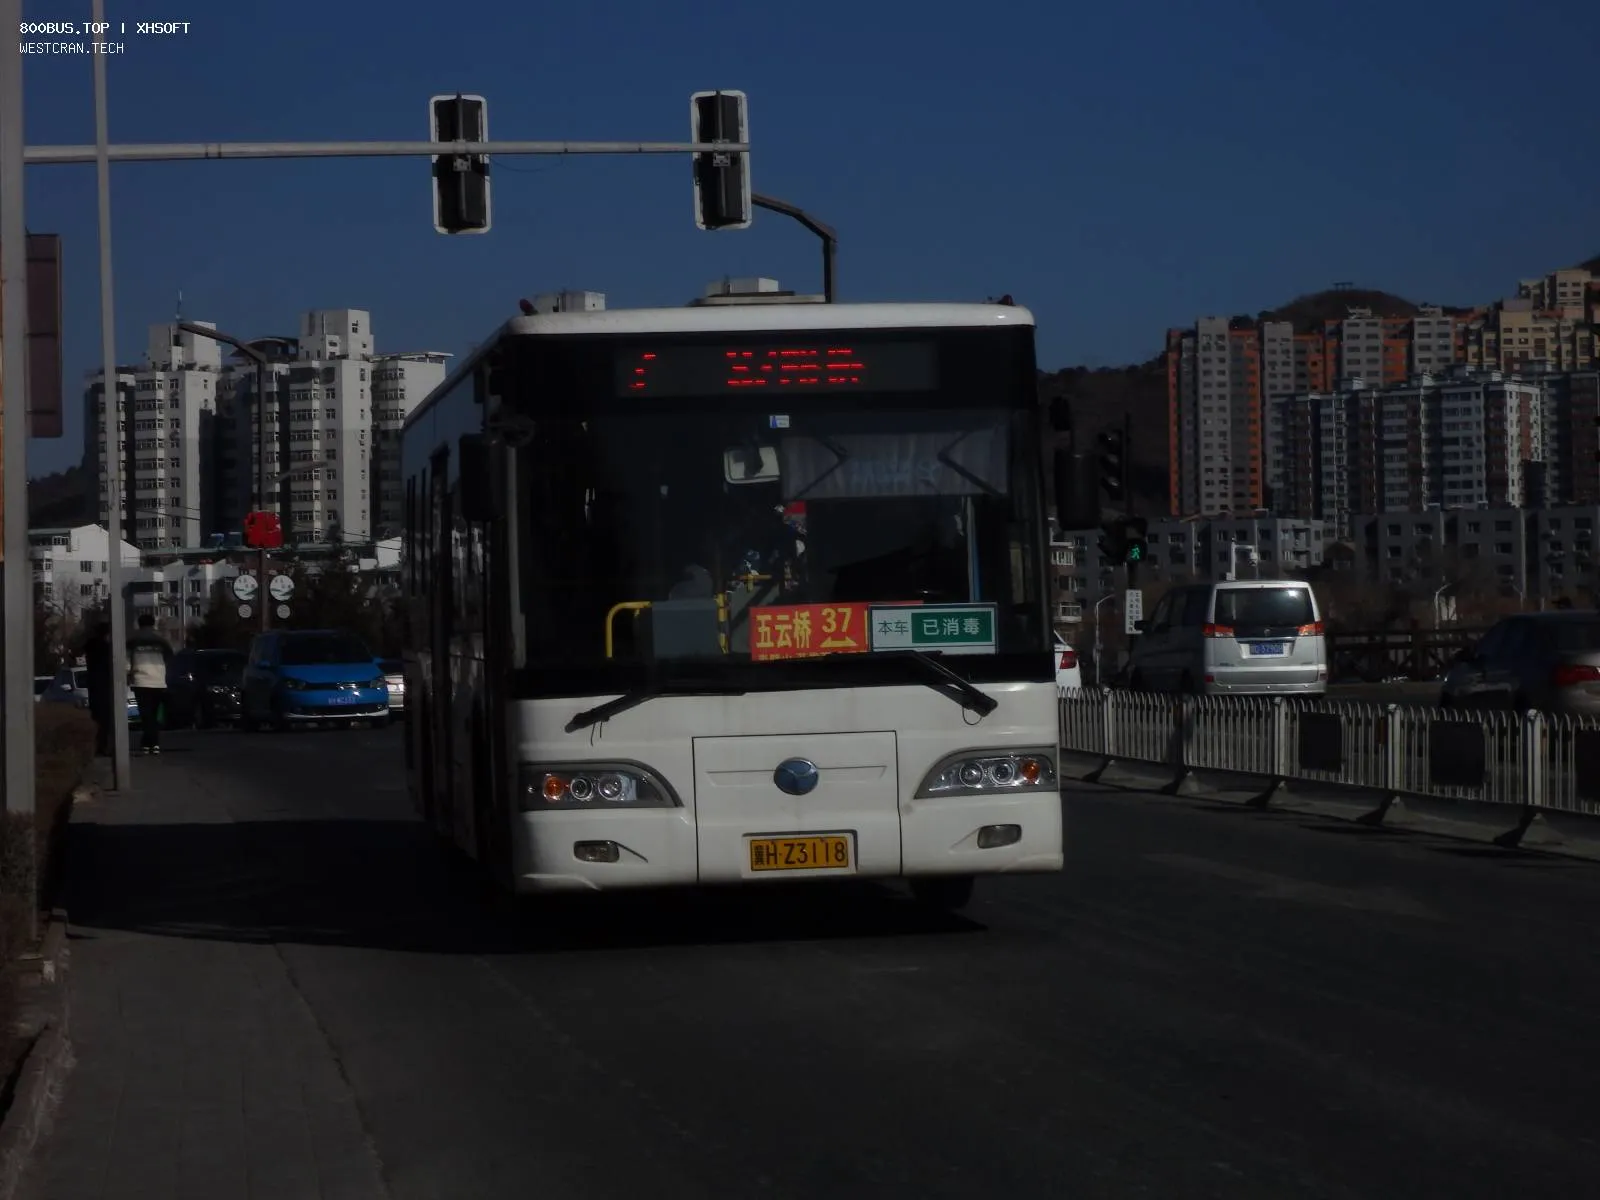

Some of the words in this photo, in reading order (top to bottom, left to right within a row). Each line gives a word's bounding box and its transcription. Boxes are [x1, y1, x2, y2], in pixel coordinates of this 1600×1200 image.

[755, 610, 812, 649] 五云桥
[821, 607, 853, 634] 37
[878, 619, 910, 636] 本车
[921, 617, 981, 636] 已消毒
